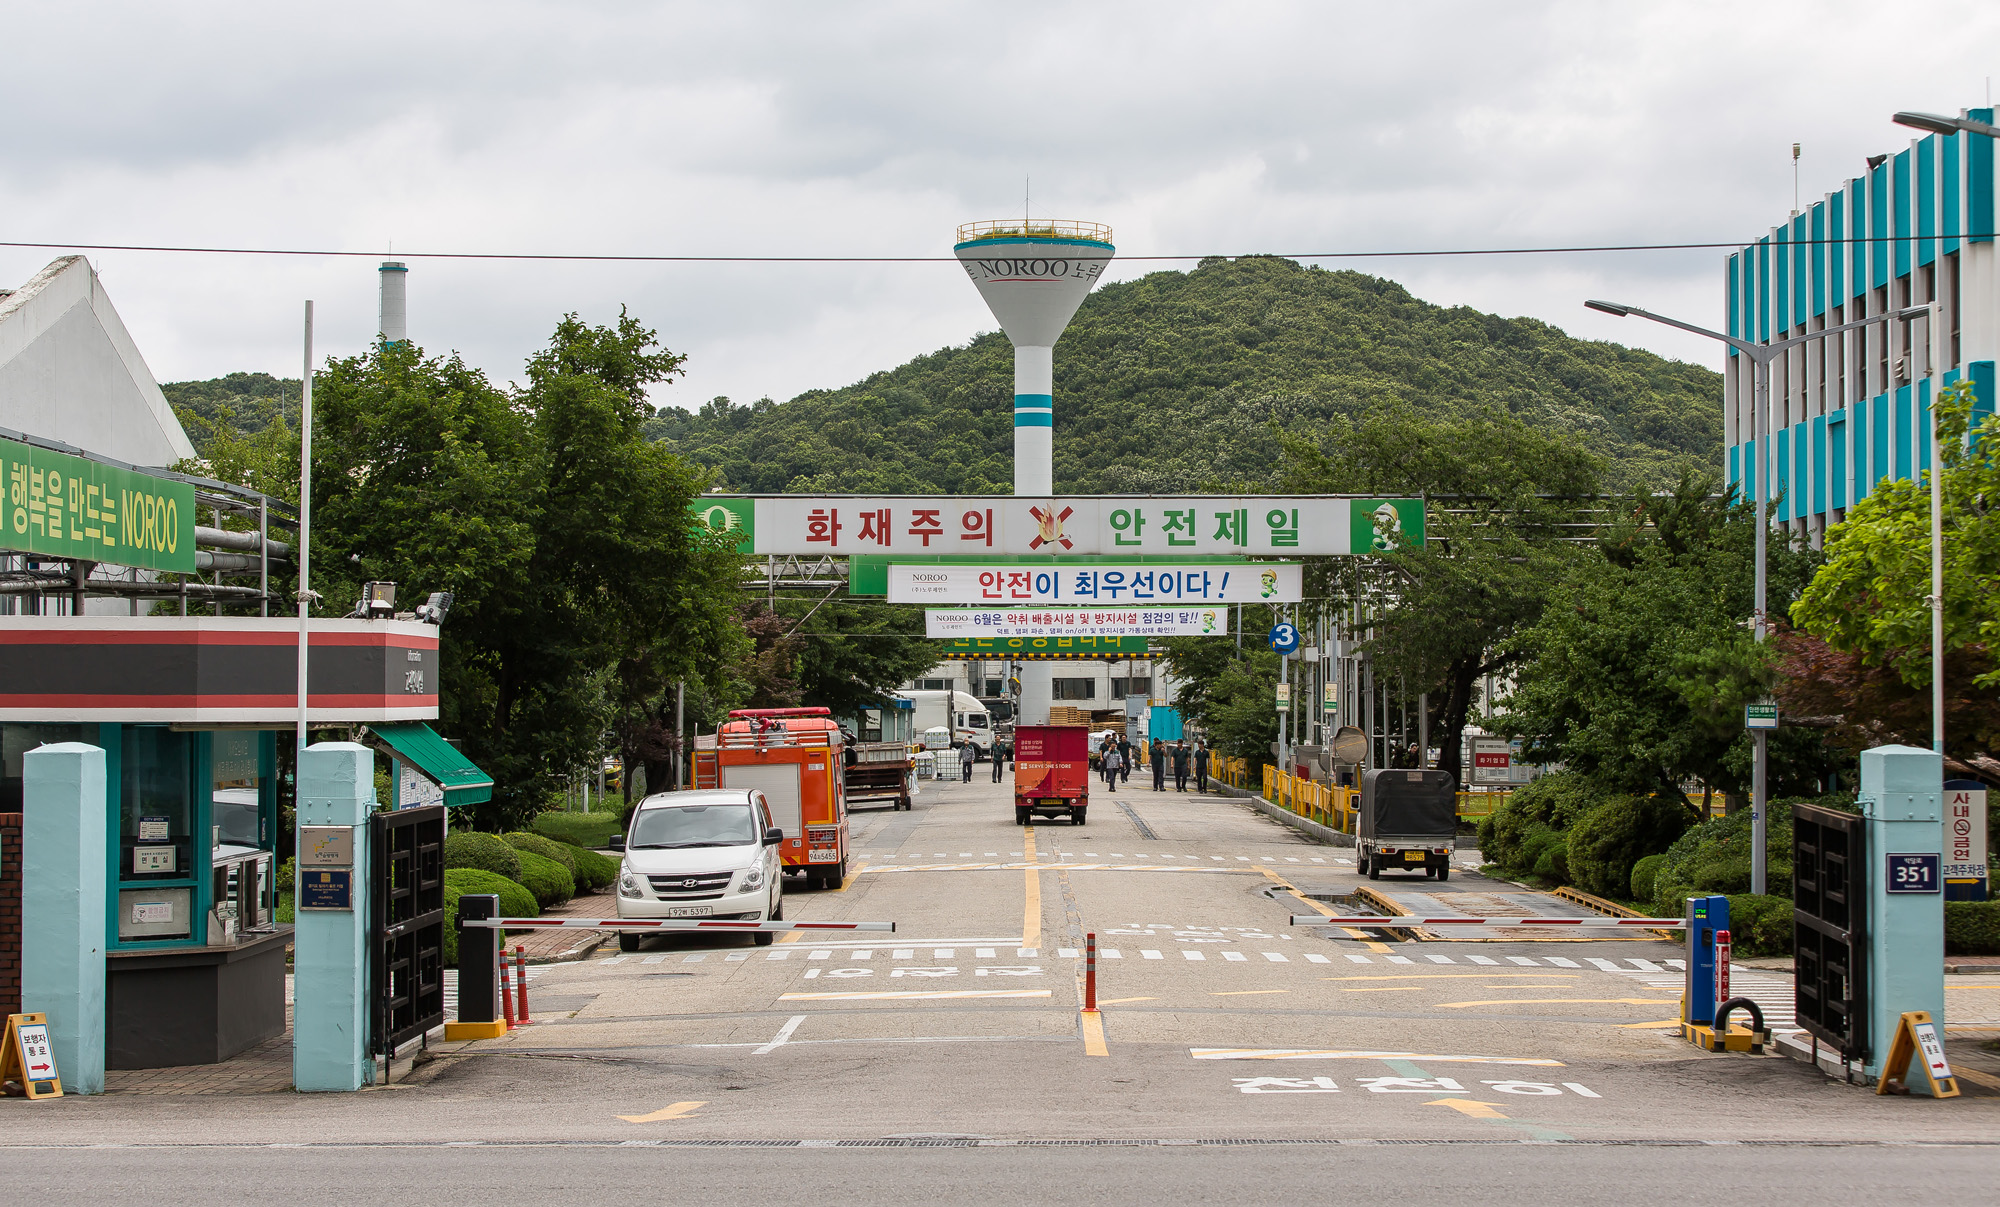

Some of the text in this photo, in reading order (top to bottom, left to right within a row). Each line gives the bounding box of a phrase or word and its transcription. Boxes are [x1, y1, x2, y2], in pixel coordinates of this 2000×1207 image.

[977, 259, 1069, 278] NOROO
[11, 461, 64, 536] 행복을
[68, 477, 117, 547] 만드는
[122, 488, 178, 554] NOROO
[806, 508, 993, 547] 화재주의
[1109, 508, 1300, 547] 안전제일
[978, 571, 1059, 599] 안전이
[974, 613, 1002, 626] 6월은
[1007, 613, 1028, 625] 악취
[1032, 613, 1074, 625] 배출시설
[1080, 613, 1089, 624] 및
[1094, 612, 1137, 624] 방지시설
[1142, 612, 1174, 624] 점검의
[1275, 625, 1294, 646] 3
[1953, 792, 1971, 861] 사내 금연
[1896, 866, 1929, 882] 351
[1943, 863, 1985, 876] 고객주차장
[24, 1033, 46, 1045] 보행자
[1231, 1076, 1603, 1098] 천천히
